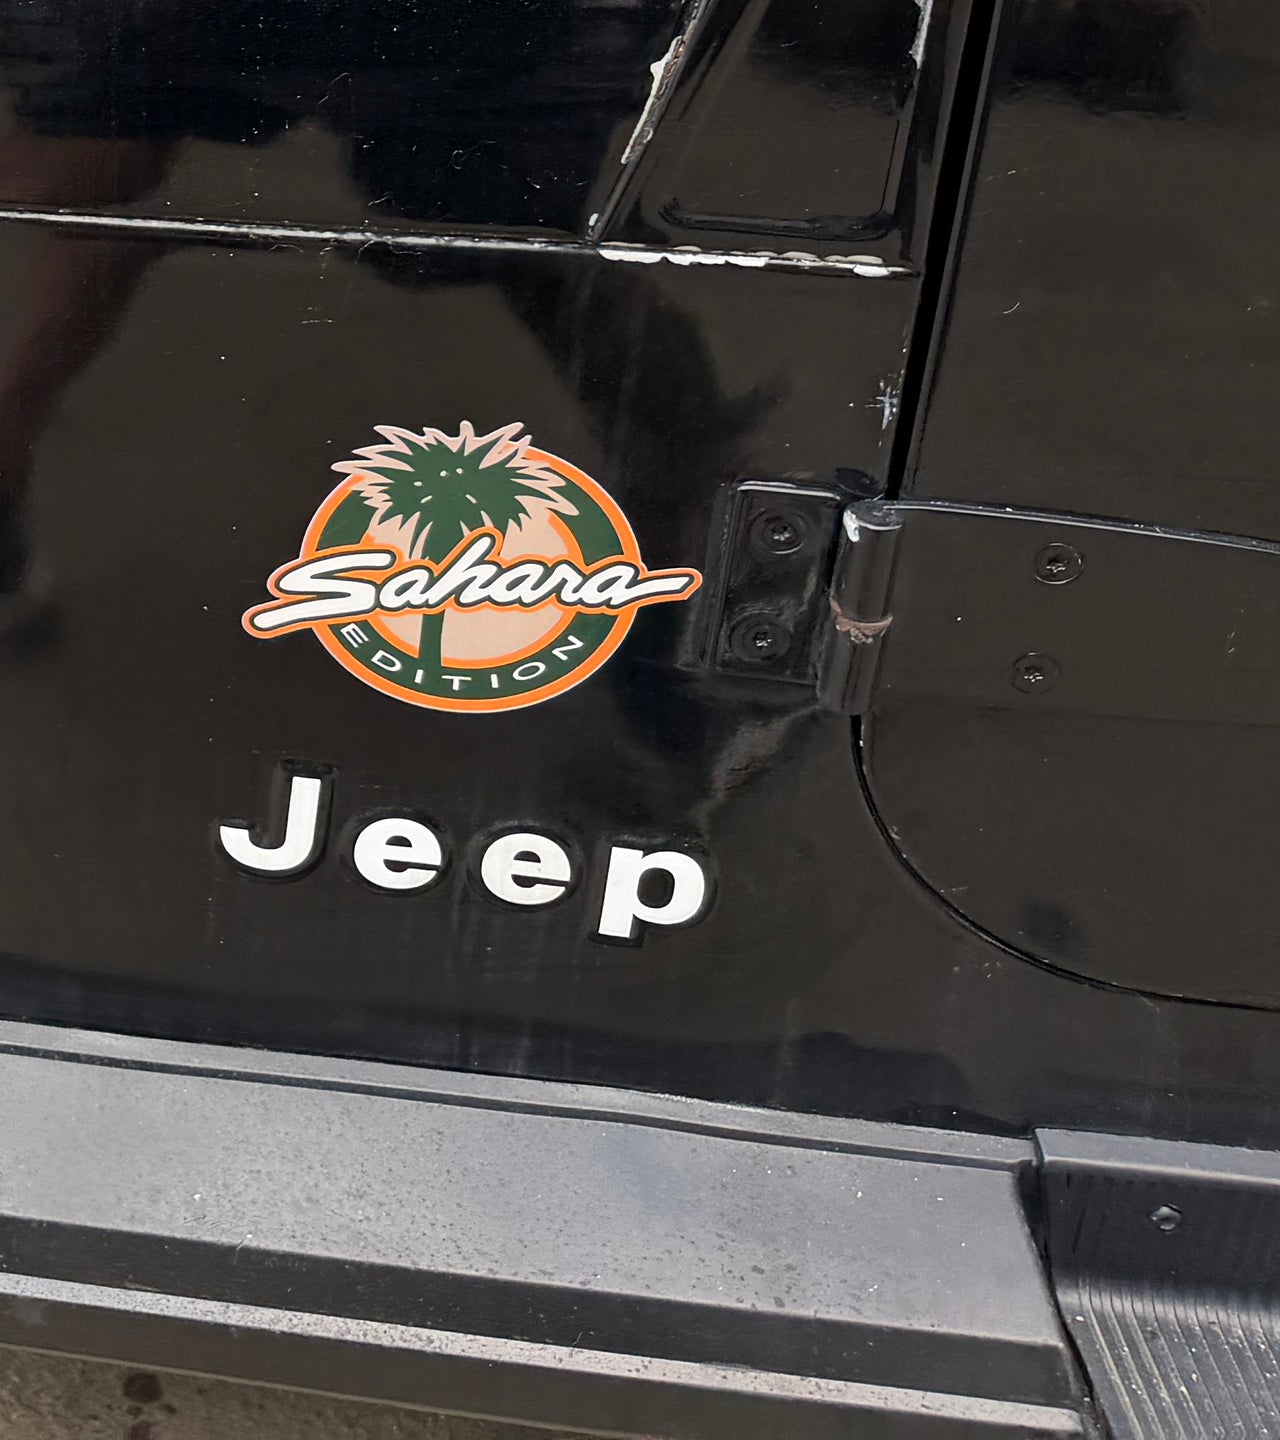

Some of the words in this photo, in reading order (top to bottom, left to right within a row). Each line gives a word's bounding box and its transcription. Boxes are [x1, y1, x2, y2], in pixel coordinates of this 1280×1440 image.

[247, 531, 697, 634] Sahara
[339, 620, 584, 693] EDITION
[219, 775, 707, 939] Jeep
